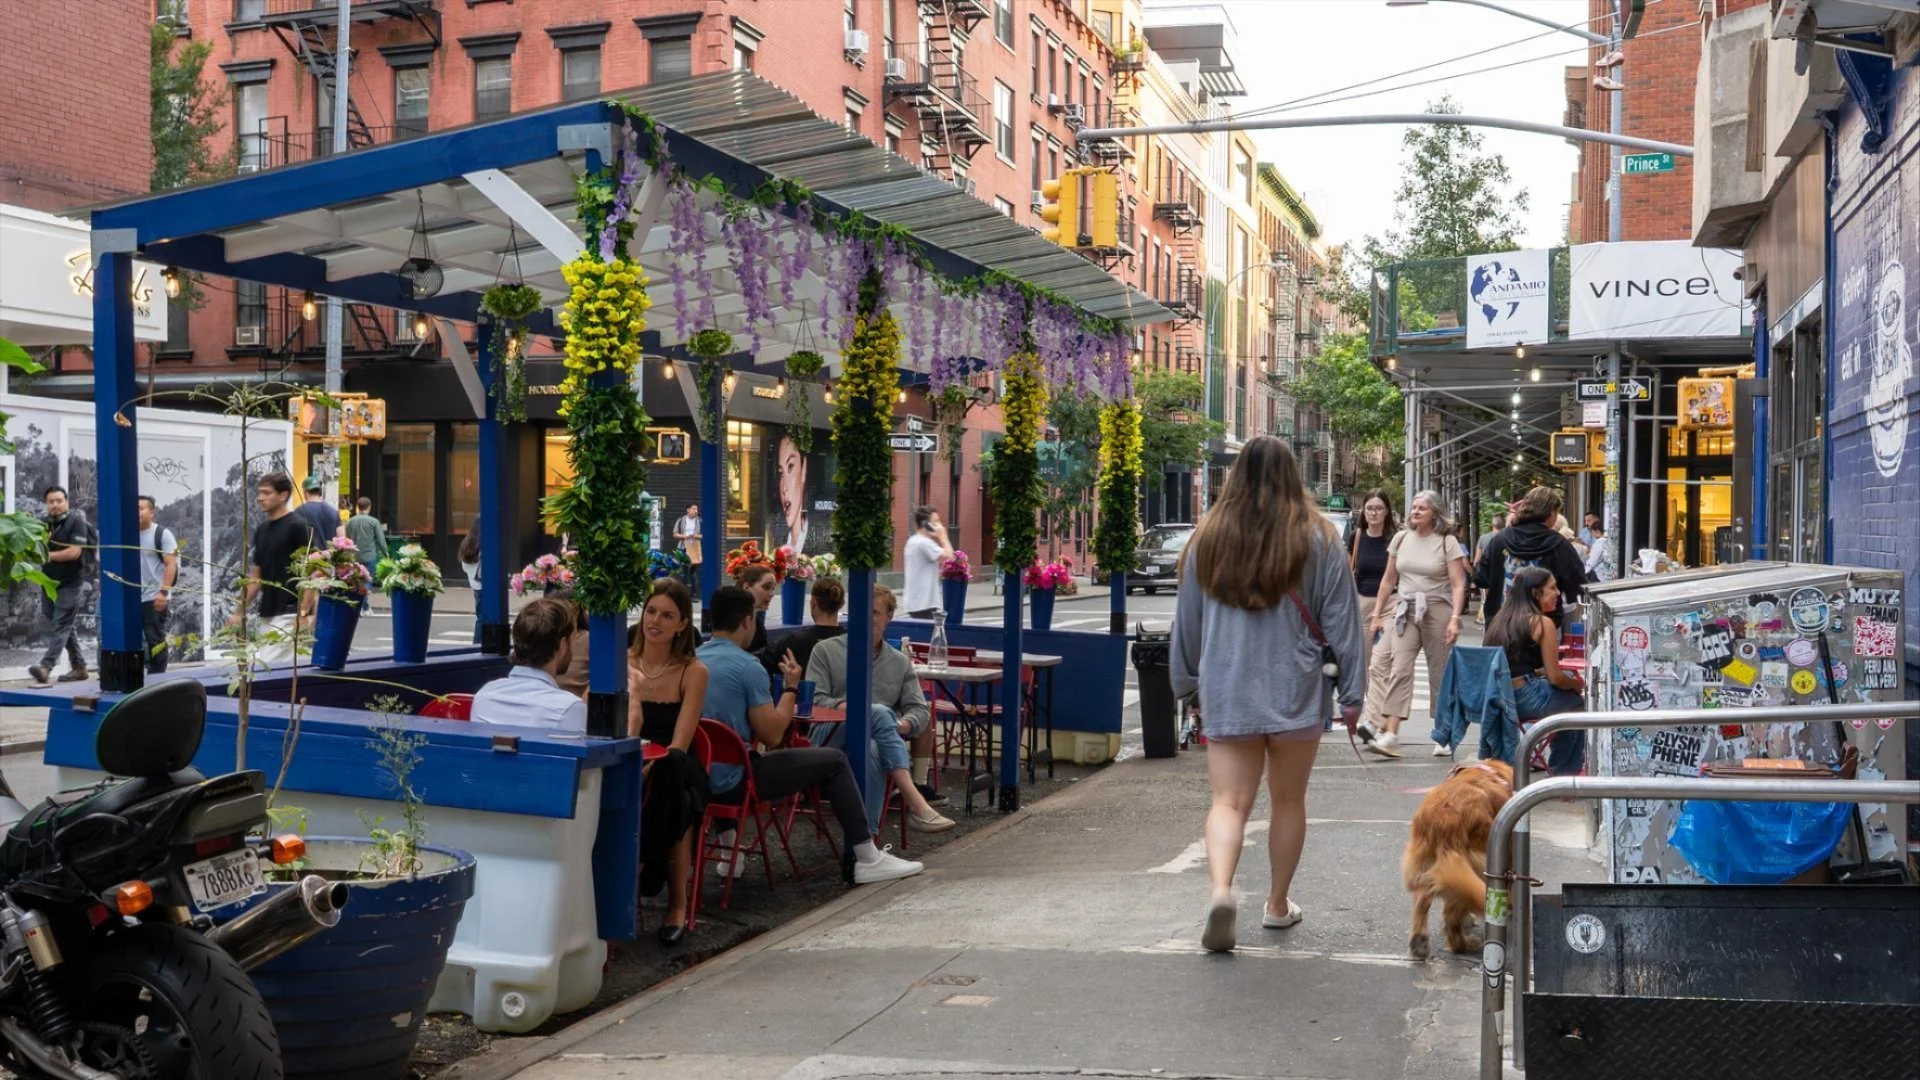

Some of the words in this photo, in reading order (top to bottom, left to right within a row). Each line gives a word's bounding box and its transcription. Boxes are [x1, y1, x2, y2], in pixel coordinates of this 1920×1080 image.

[1627, 158, 1660, 172] Prince
[1490, 280, 1546, 293] ANDAMIO
[1587, 386, 1607, 395] ONE
[1864, 660, 1881, 674] PERU
[1882, 660, 1897, 673] ANA
[1865, 675, 1879, 688] ANA
[1880, 674, 1897, 688] PERU
[1651, 745, 1699, 768] PHENE
